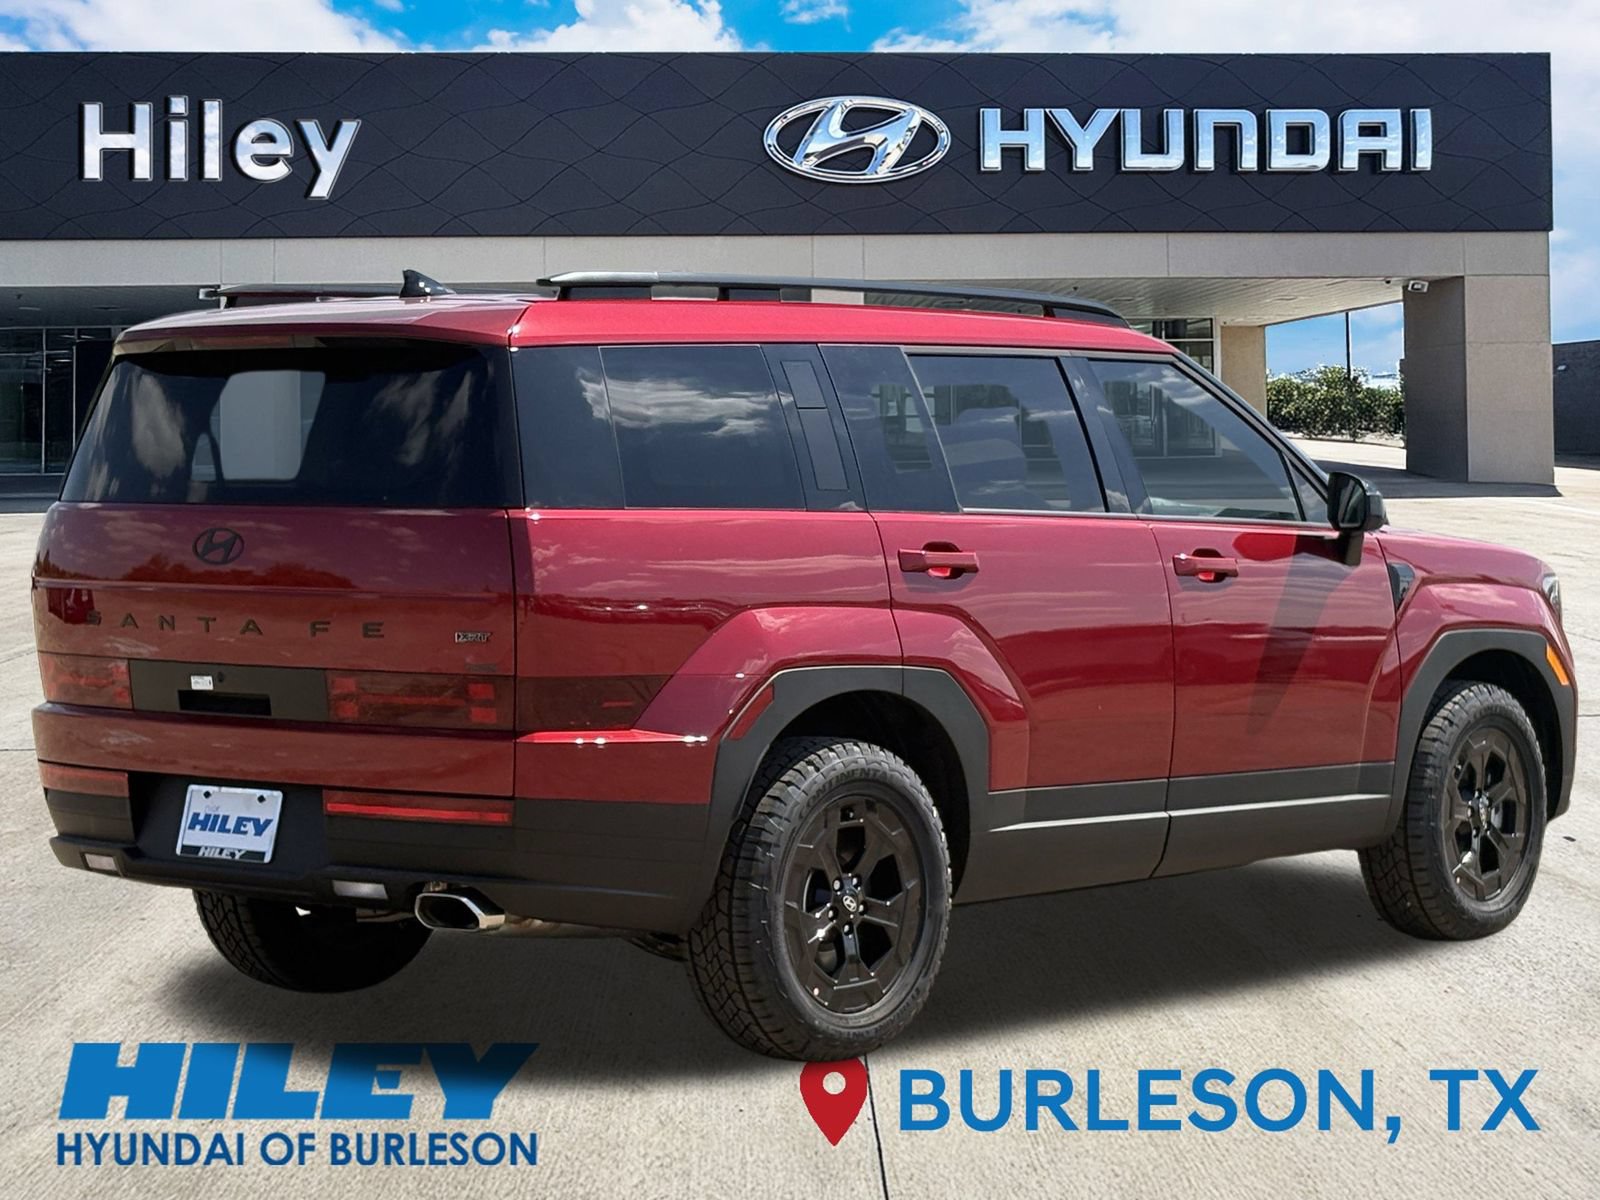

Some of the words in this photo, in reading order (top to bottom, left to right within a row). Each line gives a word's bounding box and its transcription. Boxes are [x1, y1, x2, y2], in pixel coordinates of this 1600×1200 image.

[81, 95, 361, 199] Hiley
[979, 107, 1433, 172] HYUNDAI
[87, 610, 264, 636] SANTA
[309, 620, 385, 639] FE
[187, 812, 274, 837] HILEY
[198, 845, 248, 860] HILEY
